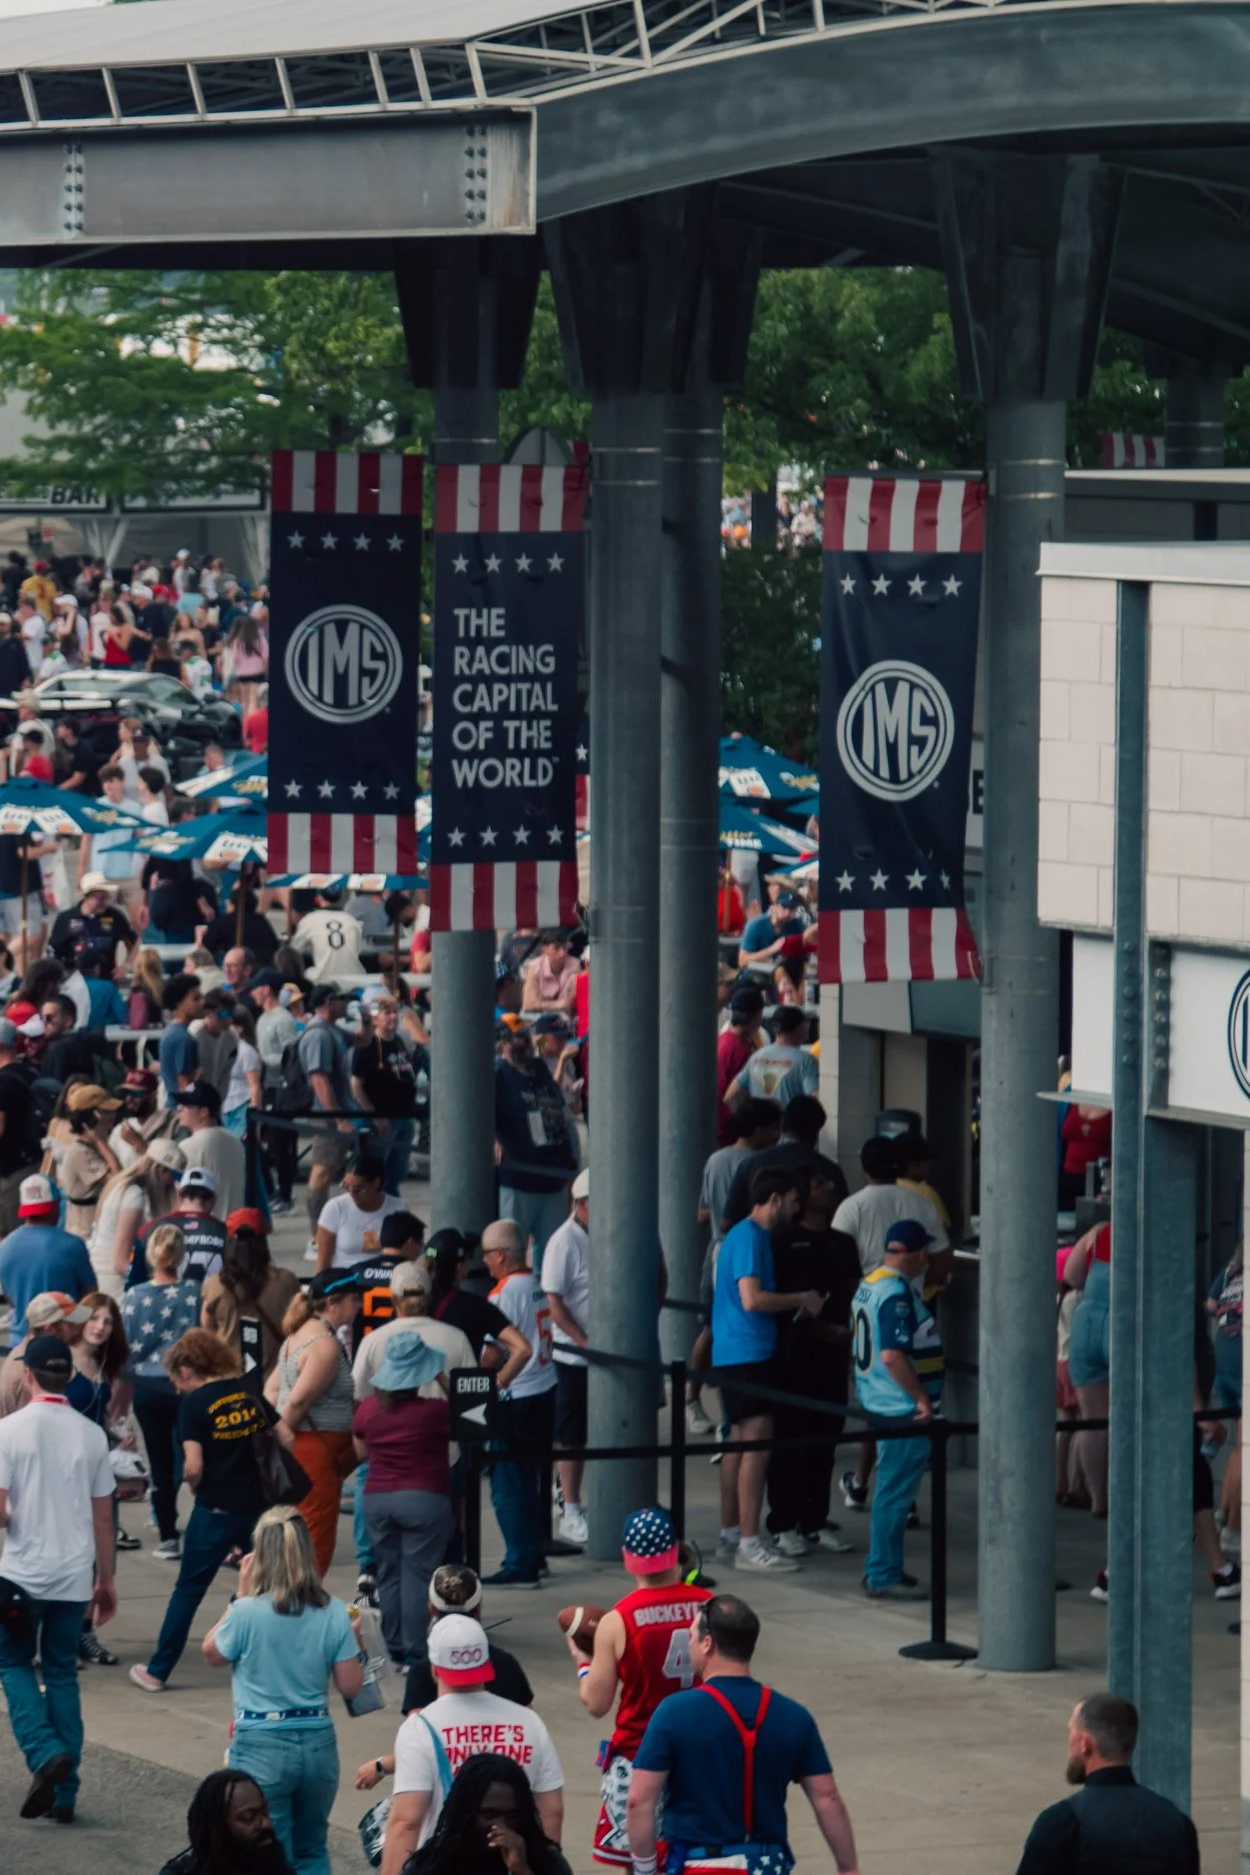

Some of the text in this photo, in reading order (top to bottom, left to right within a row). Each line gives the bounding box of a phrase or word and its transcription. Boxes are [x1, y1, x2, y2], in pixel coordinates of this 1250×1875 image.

[453, 607, 506, 637] THE
[307, 620, 387, 706] IMS
[454, 644, 556, 676] RACING
[453, 682, 559, 714] CAPITAL
[452, 719, 553, 752] OF THE
[860, 679, 938, 781] IMS
[452, 757, 554, 788] WORLD
[327, 919, 346, 950] 8
[457, 1376, 490, 1393] ENTER
[450, 1647, 483, 1666] 500
[662, 1627, 695, 1689] 4
[442, 1724, 525, 1744] THERE'S
